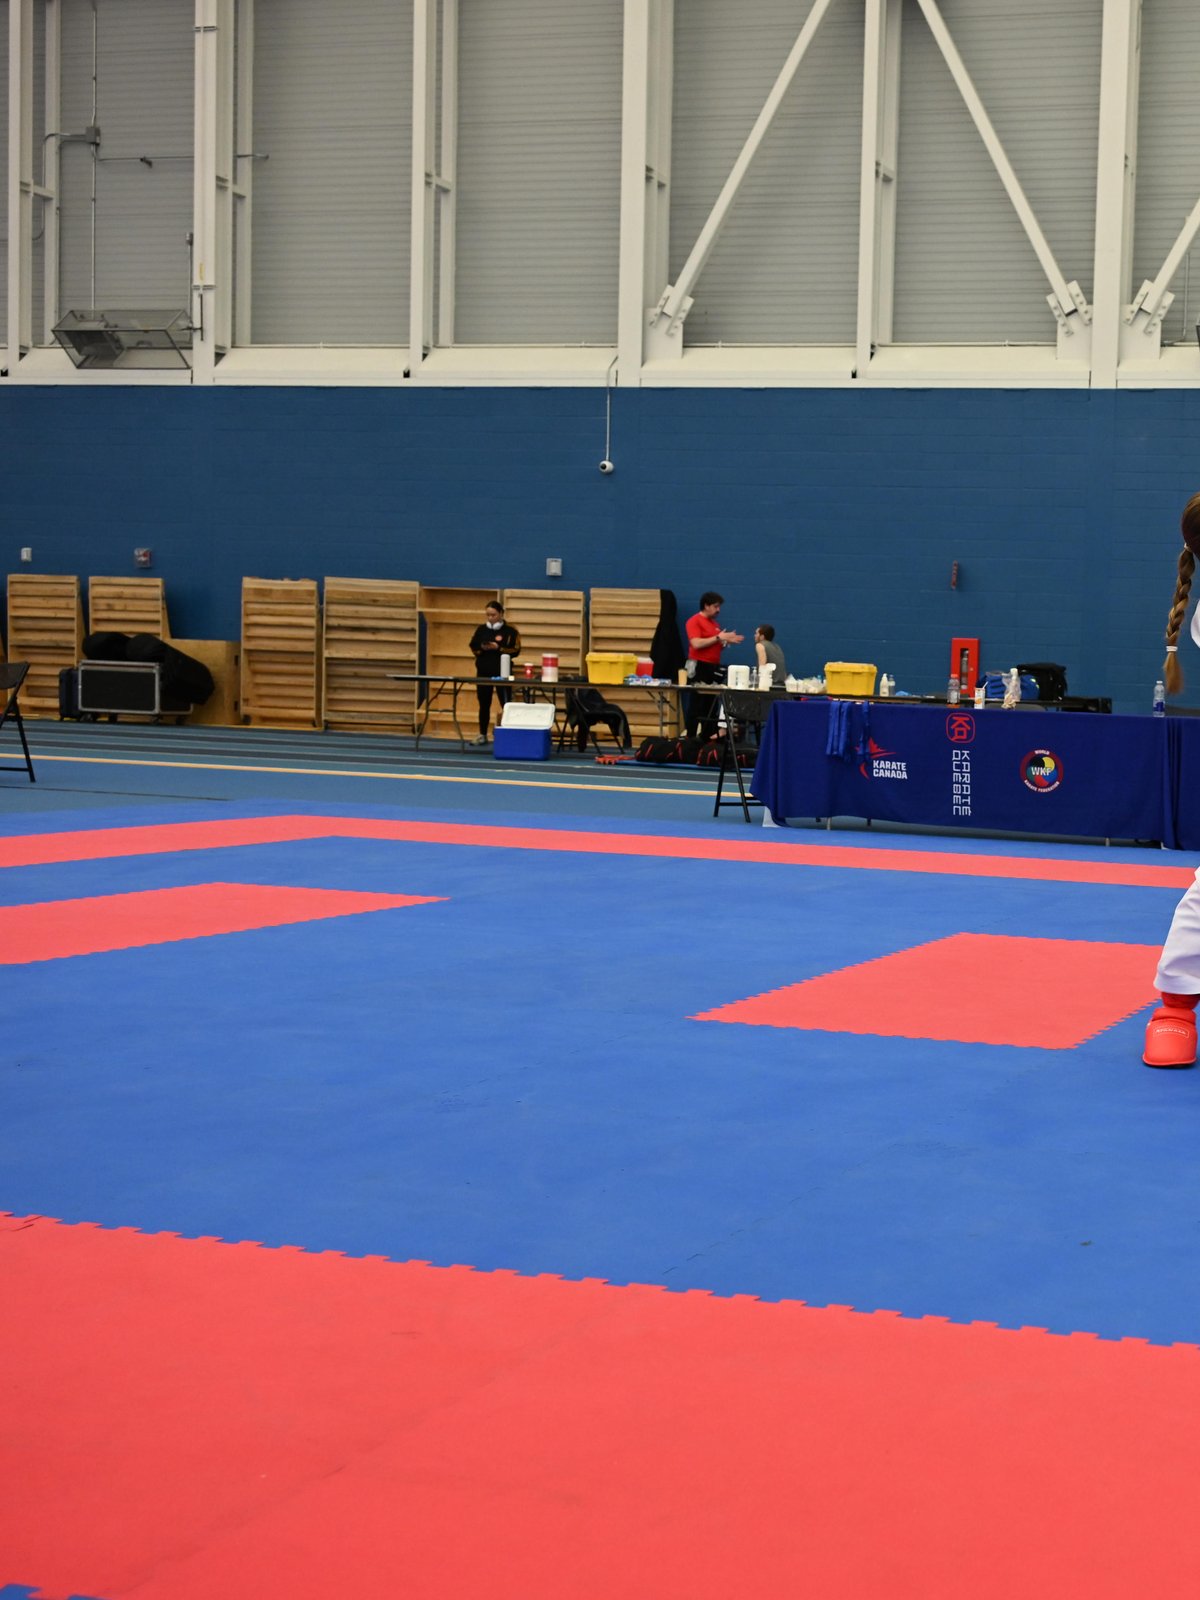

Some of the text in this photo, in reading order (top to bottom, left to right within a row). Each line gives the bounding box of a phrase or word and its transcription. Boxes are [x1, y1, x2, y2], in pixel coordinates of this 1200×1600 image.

[873, 760, 907, 770] KARATE
[873, 769, 908, 779] CANADA
[1031, 766, 1052, 776] WKF
